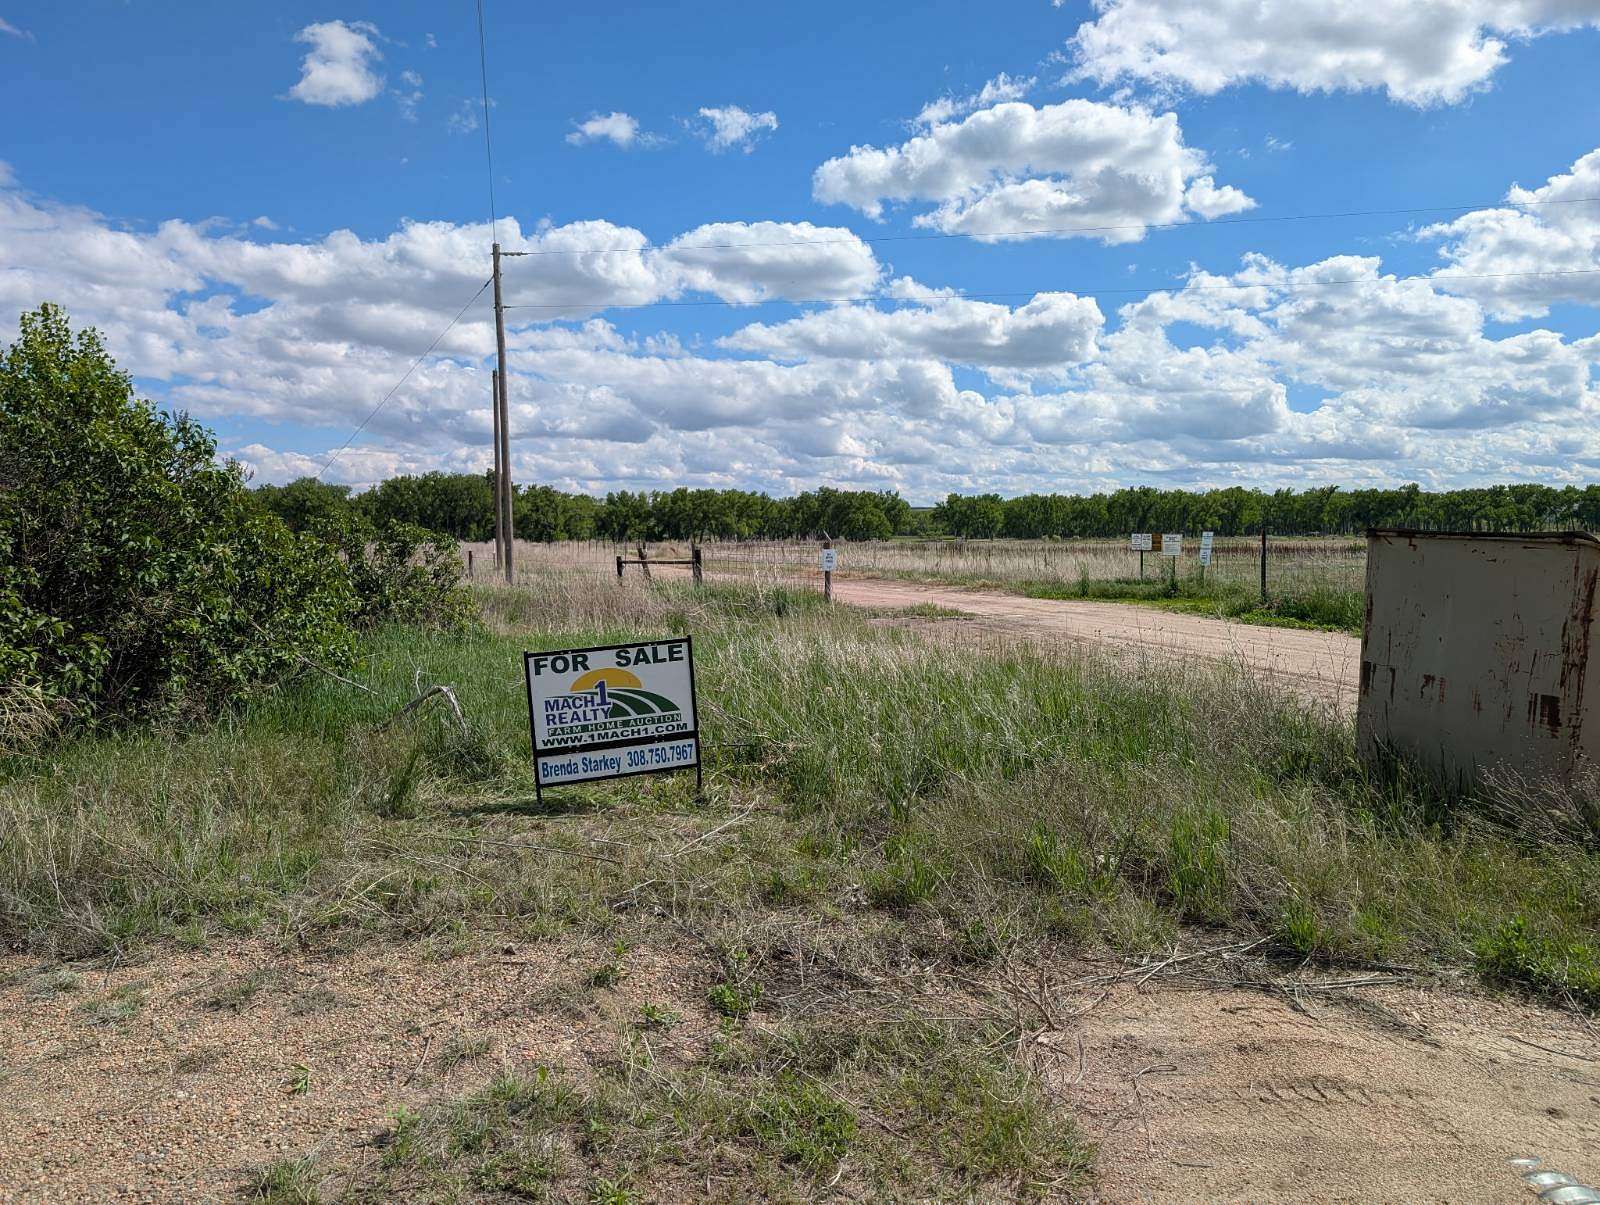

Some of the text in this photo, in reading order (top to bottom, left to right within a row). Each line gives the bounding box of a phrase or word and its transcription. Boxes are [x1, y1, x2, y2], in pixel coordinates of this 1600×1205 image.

[533, 643, 684, 676] FOR SALE
[544, 695, 595, 713] MACH
[545, 706, 611, 726] REALTY
[542, 723, 688, 747] WWW.1MACH1.COM
[548, 713, 681, 737] FARM HOME AUCTION
[542, 744, 693, 778] Brenda Starkey 308.750.7967
